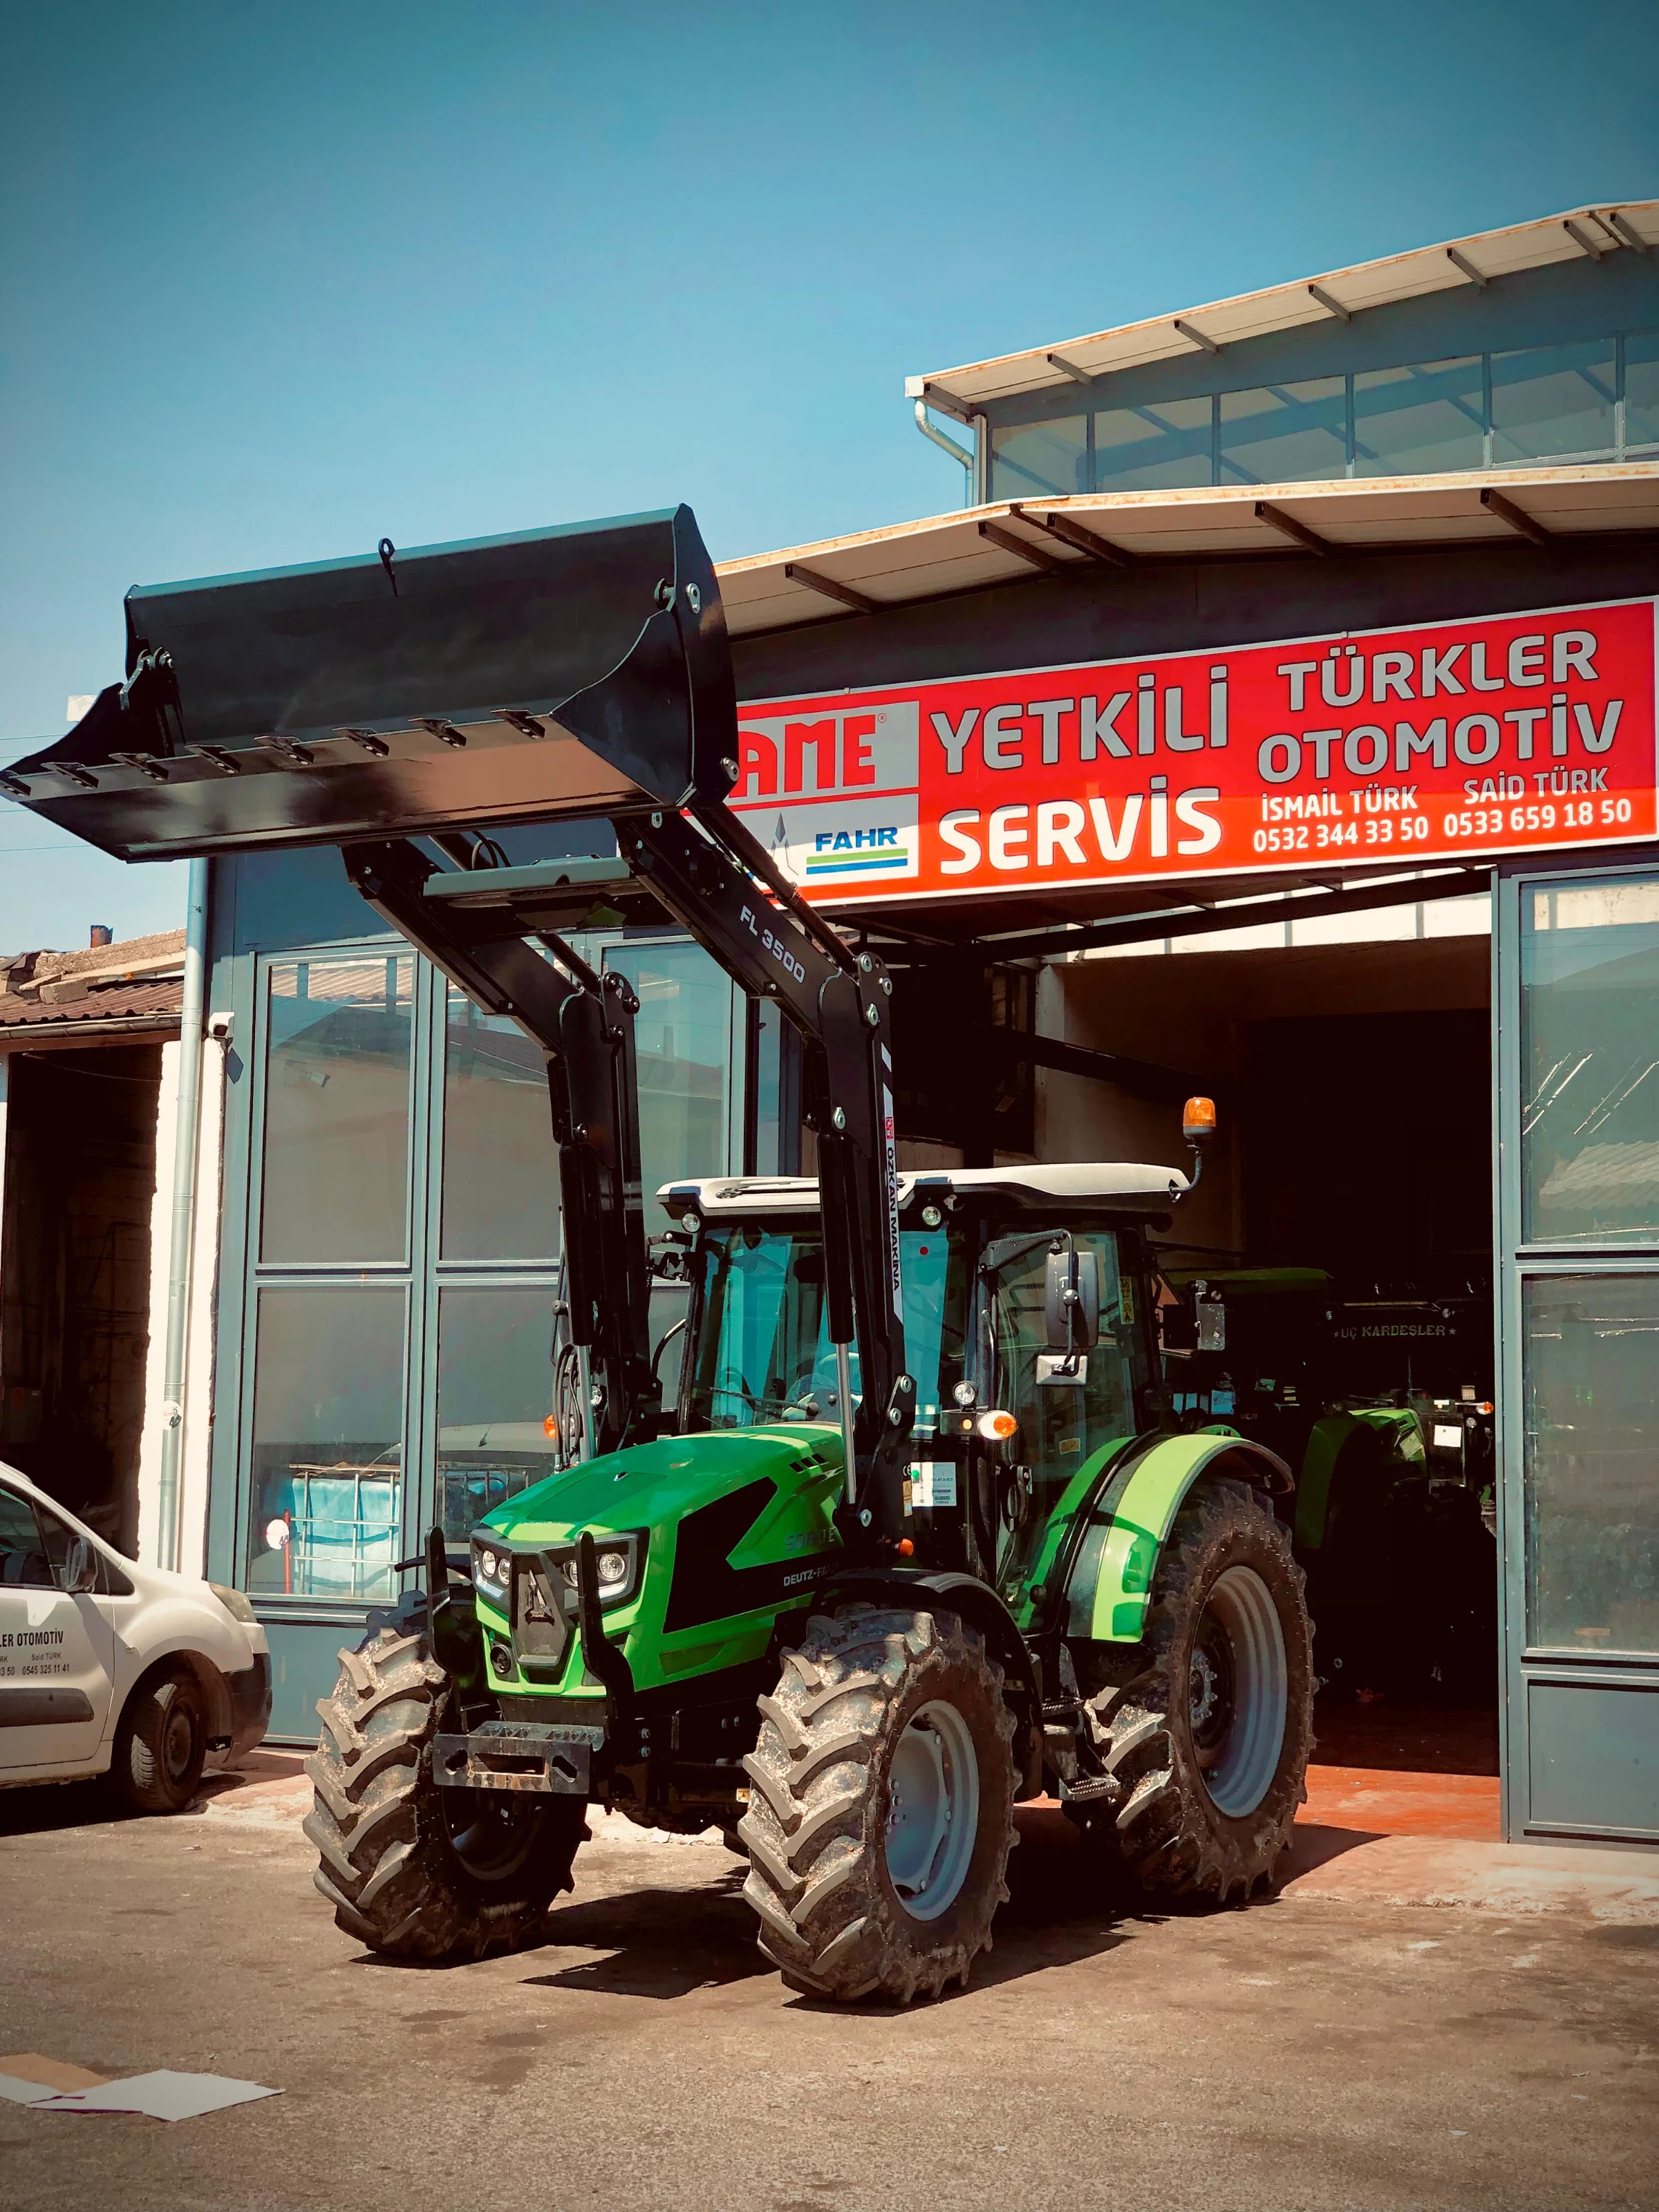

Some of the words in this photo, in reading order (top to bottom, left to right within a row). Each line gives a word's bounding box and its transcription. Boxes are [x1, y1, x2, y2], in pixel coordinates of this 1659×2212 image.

[1277, 630, 1598, 711] TÜRKLER
[930, 664, 1228, 775] YETKİLİ
[1257, 693, 1624, 783] OTOMOTİV
[1262, 785, 1342, 822] İSMAİL
[1350, 783, 1418, 814] TÜRK
[1464, 770, 1524, 805] SAİD
[1533, 765, 1609, 797] TÜRK
[939, 775, 1223, 875] SERVİS
[1253, 826, 1309, 852] 0532
[1316, 821, 1358, 847] 344
[1365, 818, 1394, 843] 33
[1400, 816, 1429, 841] 50
[1444, 811, 1503, 838] 0533
[1510, 805, 1555, 832] 659
[1563, 803, 1593, 827] 18
[1602, 798, 1631, 824] 50
[816, 827, 898, 852] FAHR
[740, 905, 758, 937] FL
[762, 928, 805, 984] 3500
[0, 1633, 14, 1648] ER
[17, 1627, 64, 1647] OTOMOTİV
[7, 1667, 15, 1676] 50
[22, 1665, 38, 1676] 0545
[40, 1665, 52, 1674] 325
[62, 1663, 70, 1672] 41
